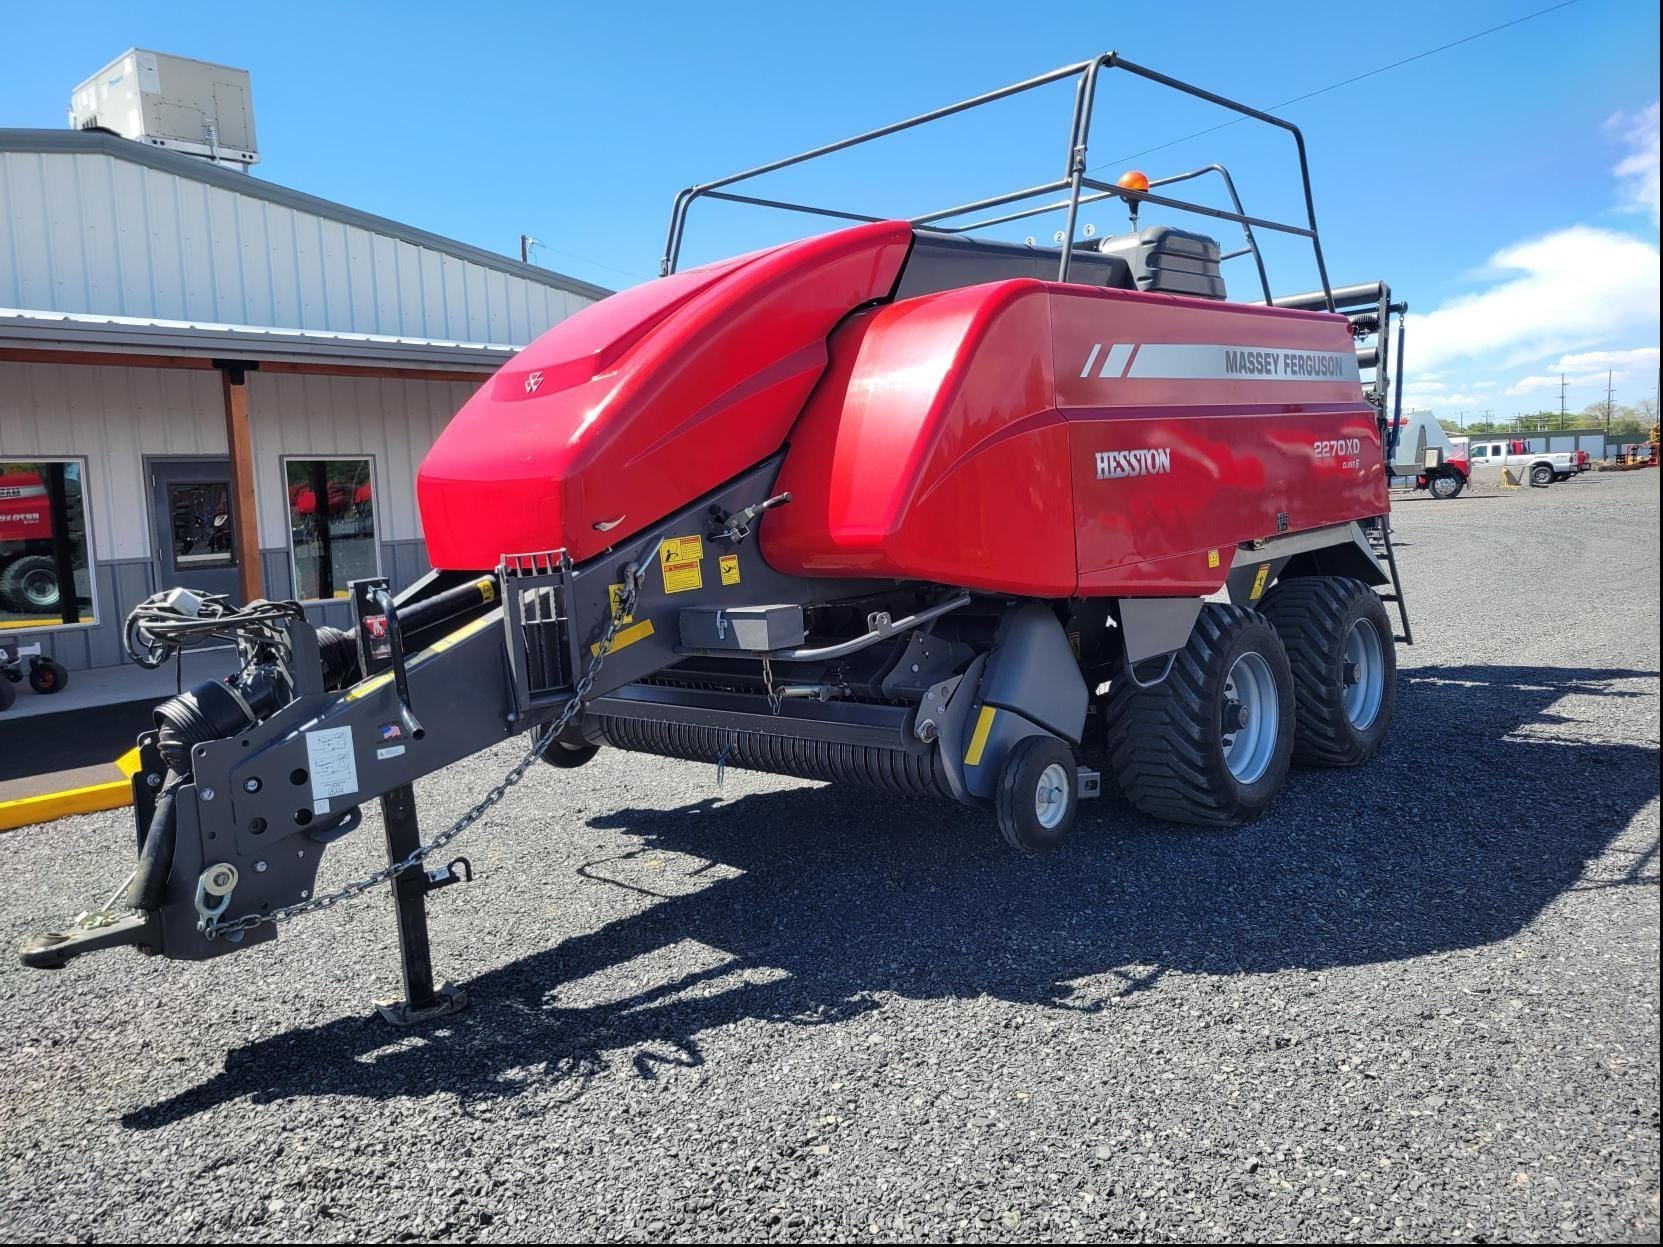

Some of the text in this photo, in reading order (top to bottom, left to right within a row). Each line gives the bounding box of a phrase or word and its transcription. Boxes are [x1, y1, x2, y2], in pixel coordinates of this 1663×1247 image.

[1225, 350, 1343, 377] MASSEY FERGUSON
[1313, 438, 1360, 458] 2270XD
[1095, 447, 1171, 480] HESSTON
